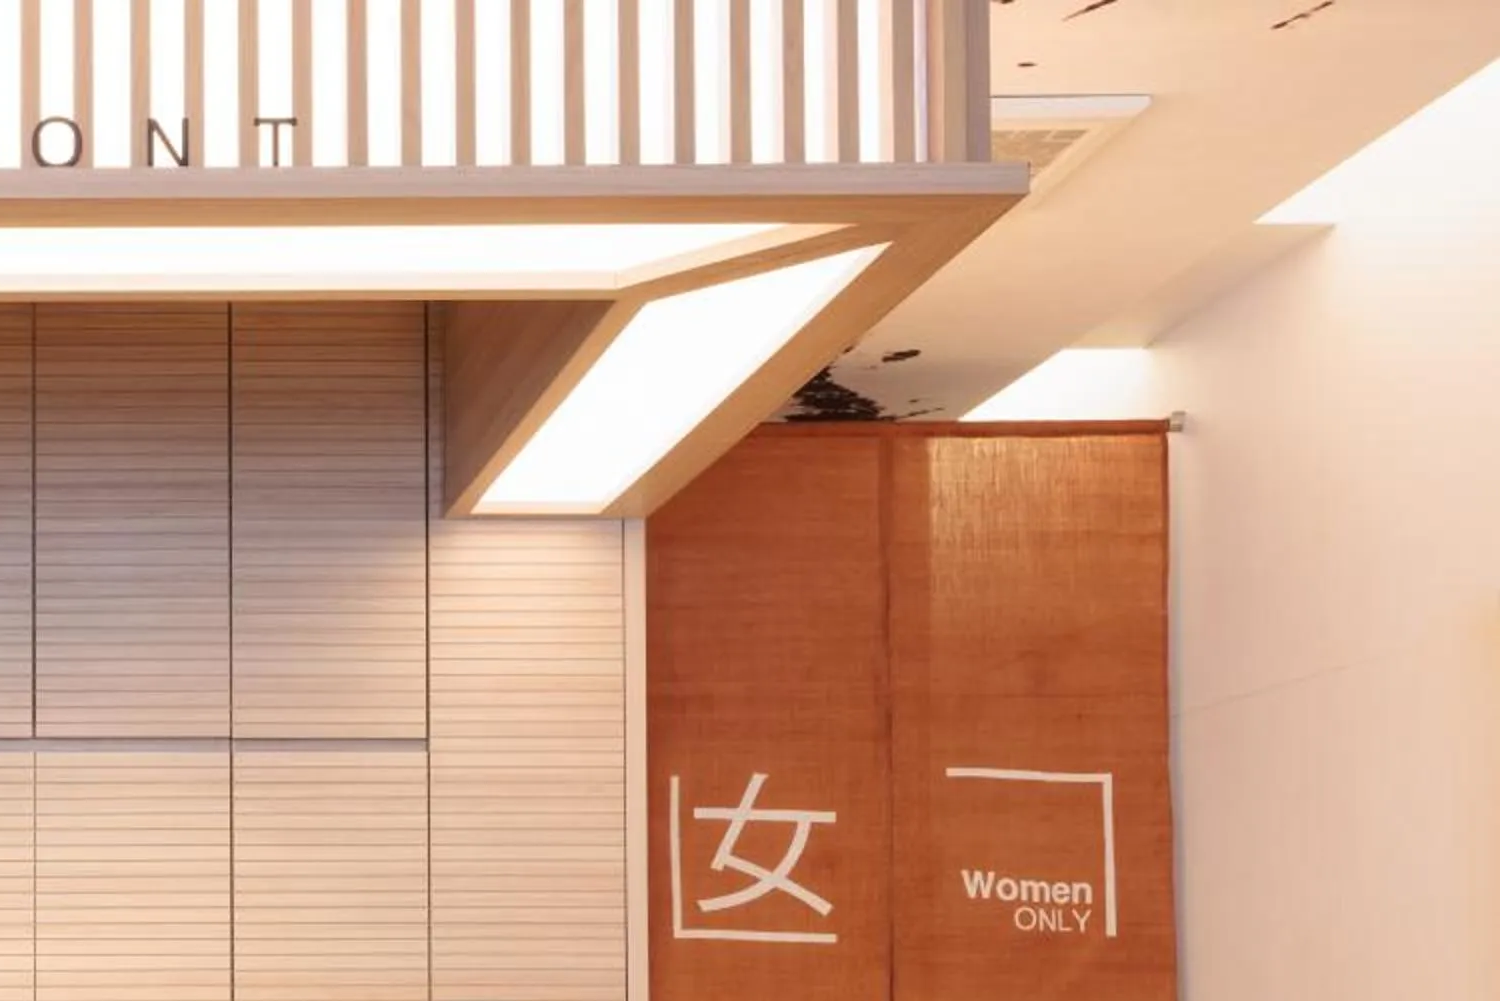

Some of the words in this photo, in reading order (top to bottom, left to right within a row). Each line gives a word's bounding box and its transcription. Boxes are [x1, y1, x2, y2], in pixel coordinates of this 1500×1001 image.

[694, 773, 836, 916] 女
[961, 869, 1093, 905] Women
[1013, 906, 1090, 933] ONLY
